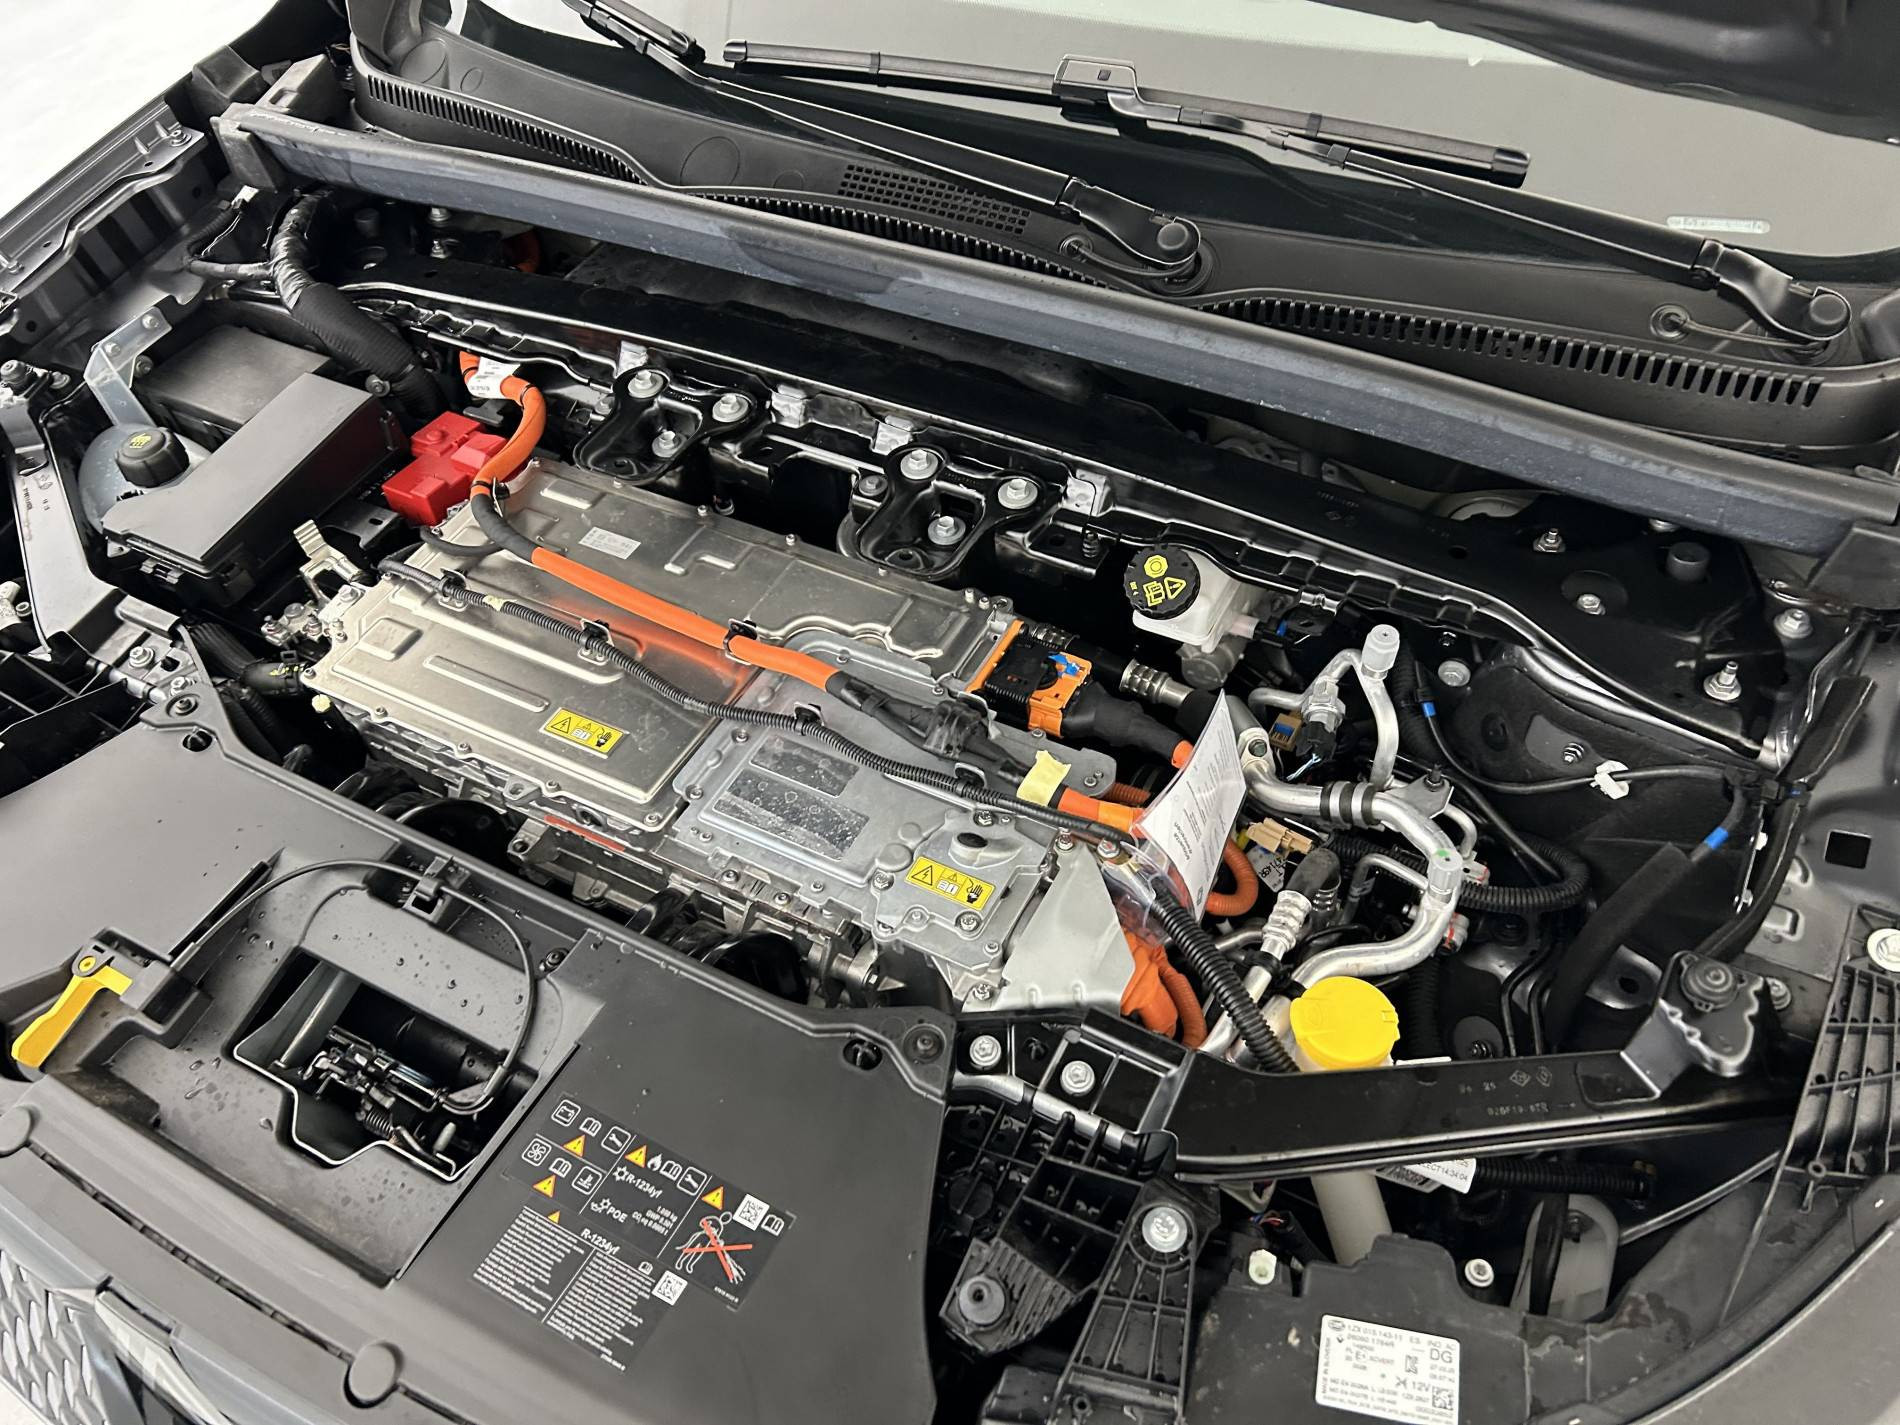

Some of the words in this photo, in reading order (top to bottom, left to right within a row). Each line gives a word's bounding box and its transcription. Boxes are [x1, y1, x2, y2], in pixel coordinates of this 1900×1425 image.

[625, 1173, 663, 1199] R-1234yf
[606, 1206, 628, 1223] POE
[580, 1228, 620, 1255] R-1234yf
[1430, 1348, 1453, 1364] DG
[1411, 1380, 1431, 1392] 12V
